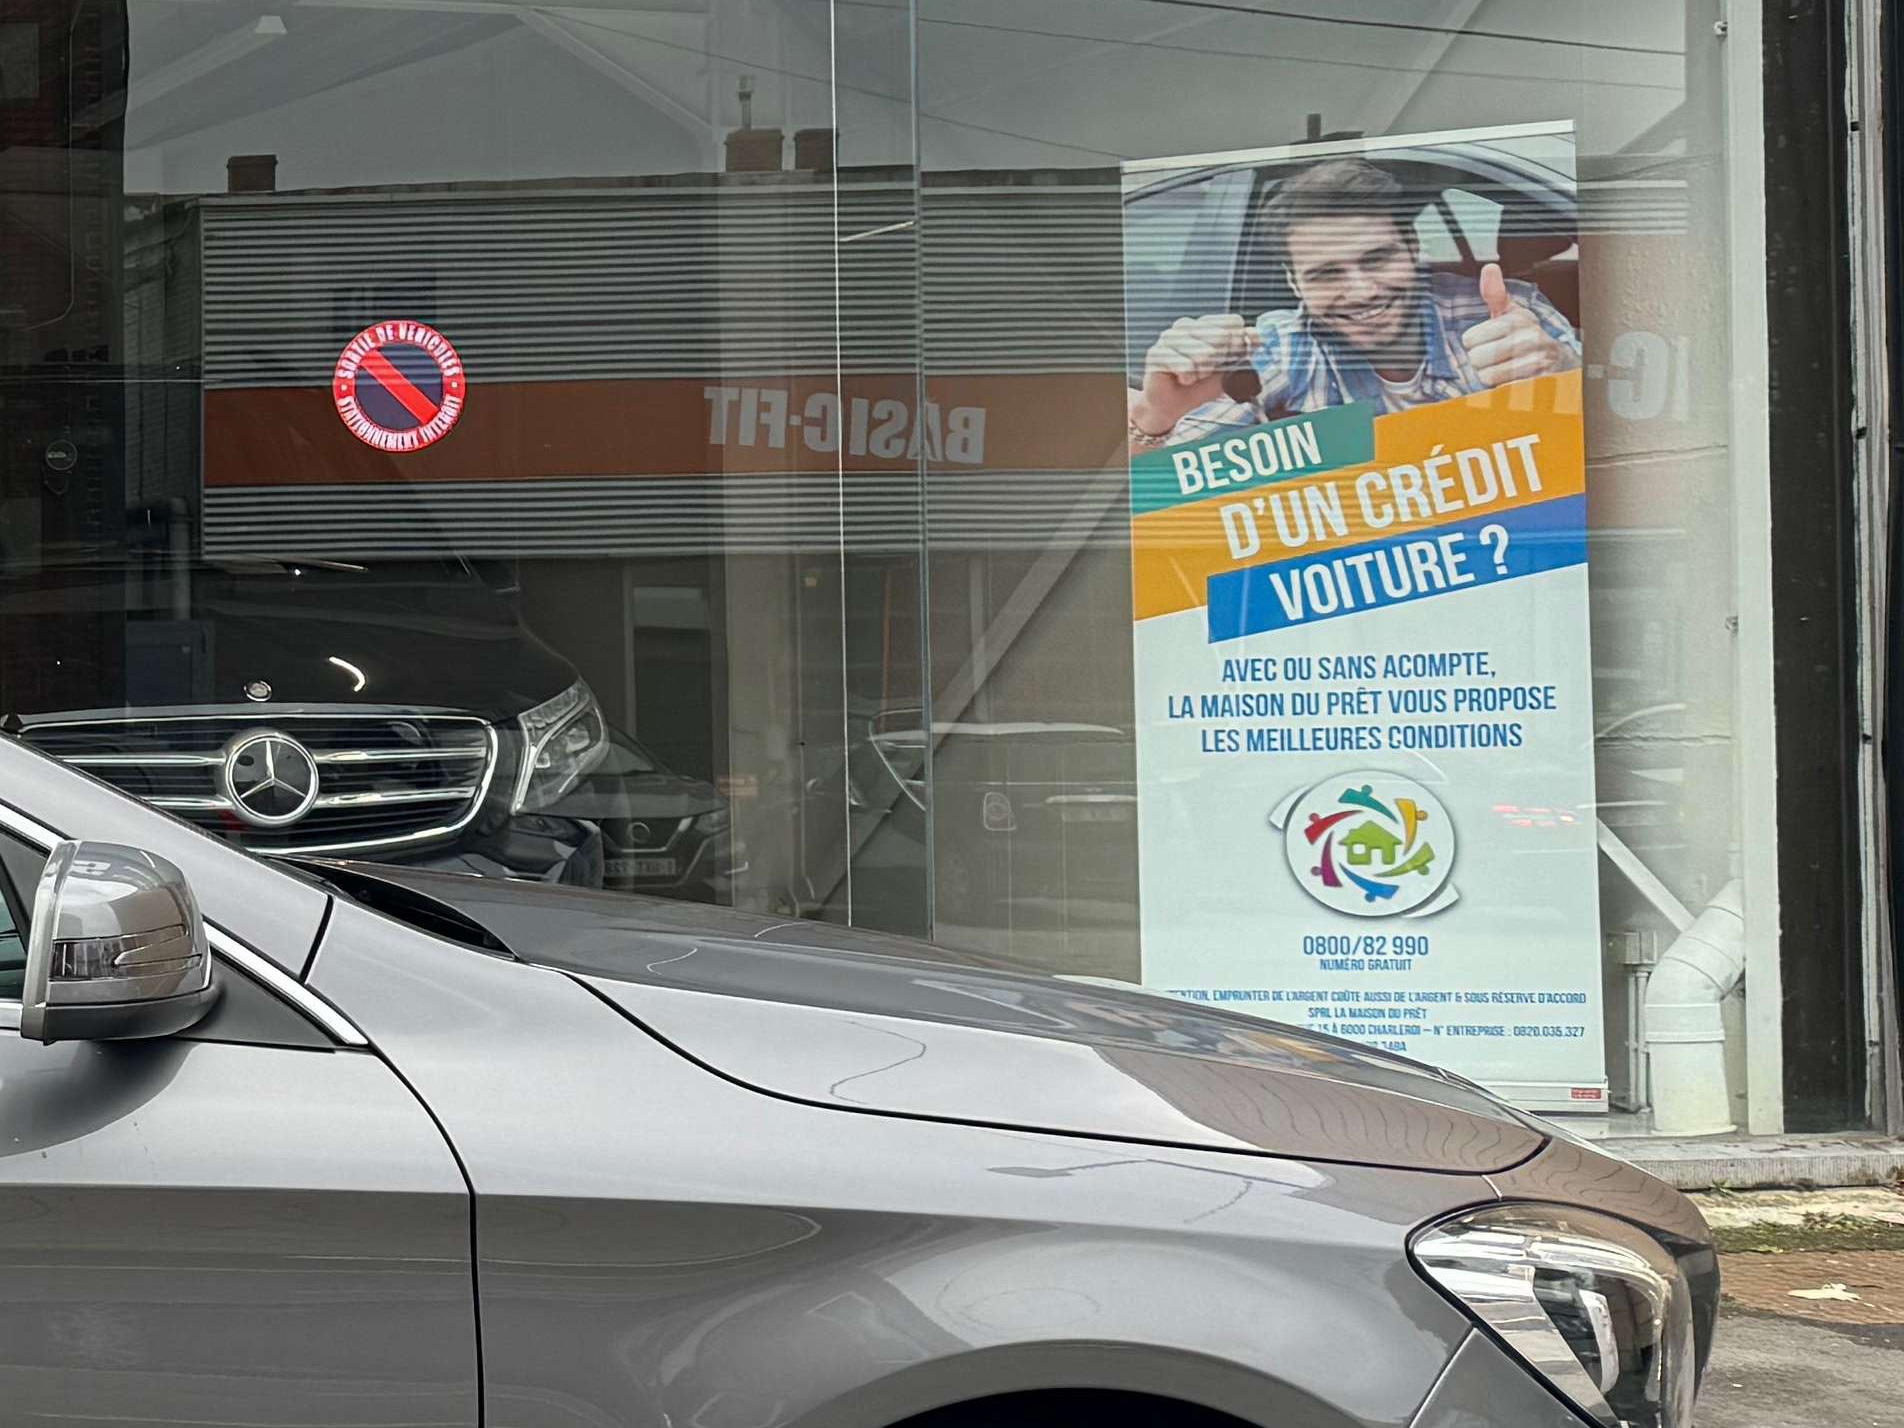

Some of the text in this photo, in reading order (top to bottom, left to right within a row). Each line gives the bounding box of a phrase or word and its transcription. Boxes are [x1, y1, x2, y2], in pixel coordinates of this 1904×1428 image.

[337, 331, 375, 379] SORTIE
[375, 324, 394, 342] DE
[1171, 420, 1322, 496] BESOIN
[1218, 433, 1544, 561] D'UN CRÉDIT
[1268, 523, 1510, 622] VOITURE ?
[1221, 651, 1497, 683] AVEC OU SANS ACOMPTE,
[1168, 686, 1557, 719] LA MAISON DU PRÊT VOUS PROPOSE
[1201, 722, 1523, 754] LES MEILLEURES CONDITIONS
[1302, 935, 1430, 957] 0800/82 990
[1319, 958, 1413, 971] NUMÉRO GRATUIT
[1213, 990, 1270, 1001] EMPRUNTER
[1272, 990, 1285, 1001] DE
[1286, 990, 1329, 1002] L'ARGENT
[1330, 988, 1361, 1002] COÛTE
[1363, 991, 1392, 1002] AUSSI
[1393, 992, 1407, 1002] DE
[1408, 992, 1453, 1003] L'ARGENT
[1464, 992, 1490, 1003] SOUS
[1491, 990, 1536, 1004] RÉSERVE
[1537, 992, 1587, 1004] D'ACCORD
[1307, 1006, 1427, 1020] SPRL LA MAISON DU PRÊT
[1340, 1023, 1366, 1035] 6000
[1367, 1024, 1422, 1036] CHARLEROI
[1446, 1025, 1506, 1037] ENTREPRISE
